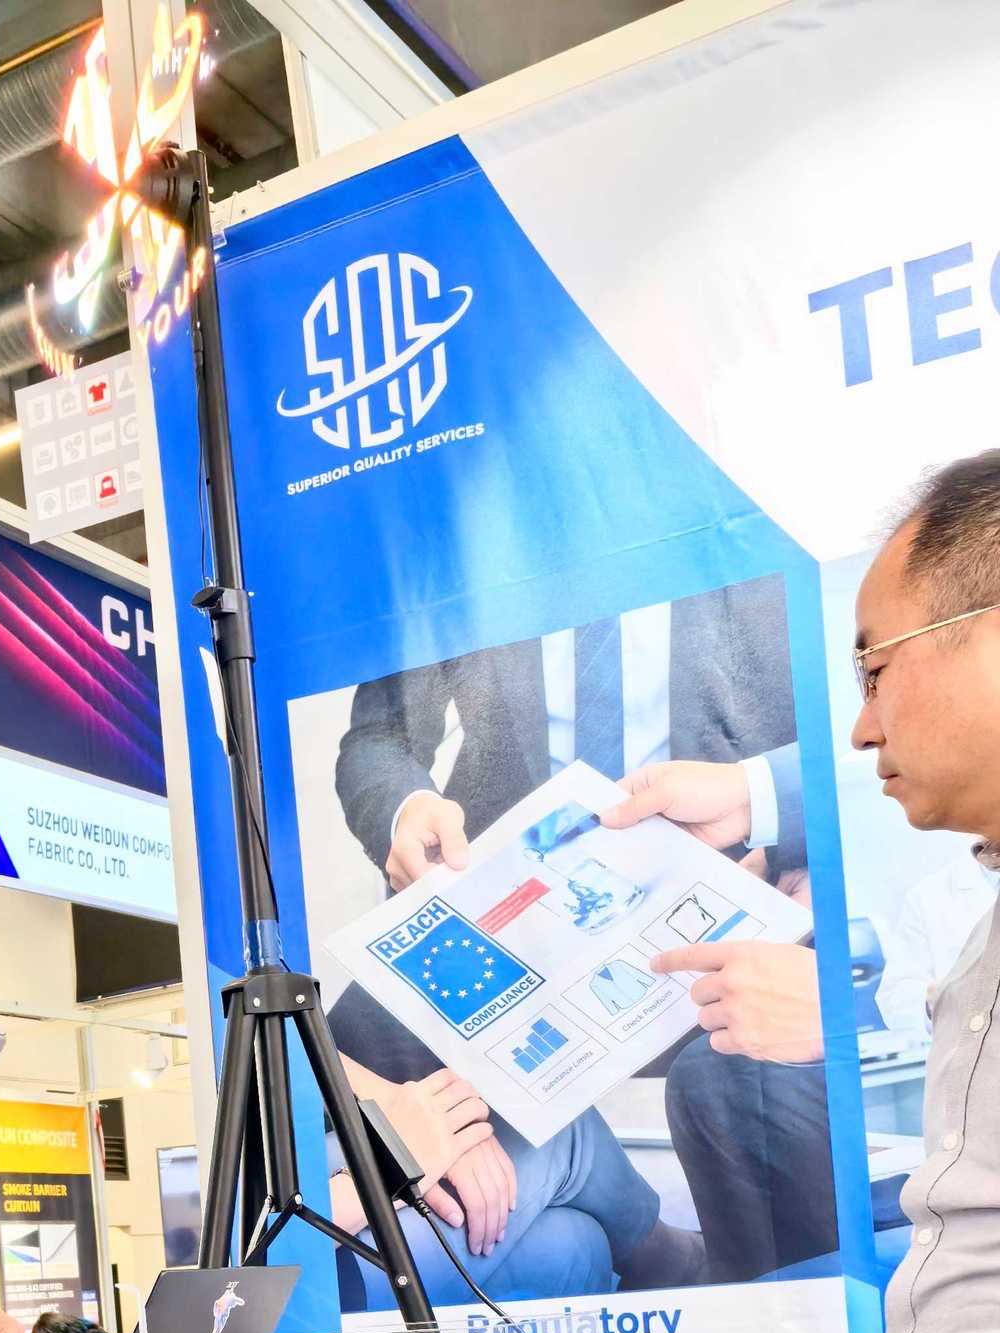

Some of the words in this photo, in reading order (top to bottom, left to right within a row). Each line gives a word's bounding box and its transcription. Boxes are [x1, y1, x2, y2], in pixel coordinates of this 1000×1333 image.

[808, 242, 1000, 387] TE
[287, 465, 350, 495] SUPERIOR
[353, 445, 412, 473] QUALITY
[416, 423, 485, 452] SERVICES
[27, 807, 78, 836] SUZHOU
[81, 820, 129, 850] WEIDUN
[28, 837, 74, 865] FABRIC
[78, 850, 101, 874] CO.,
[104, 856, 130, 878] LTD.
[375, 902, 449, 960] REACH
[463, 975, 537, 1033] COMPLIANCE
